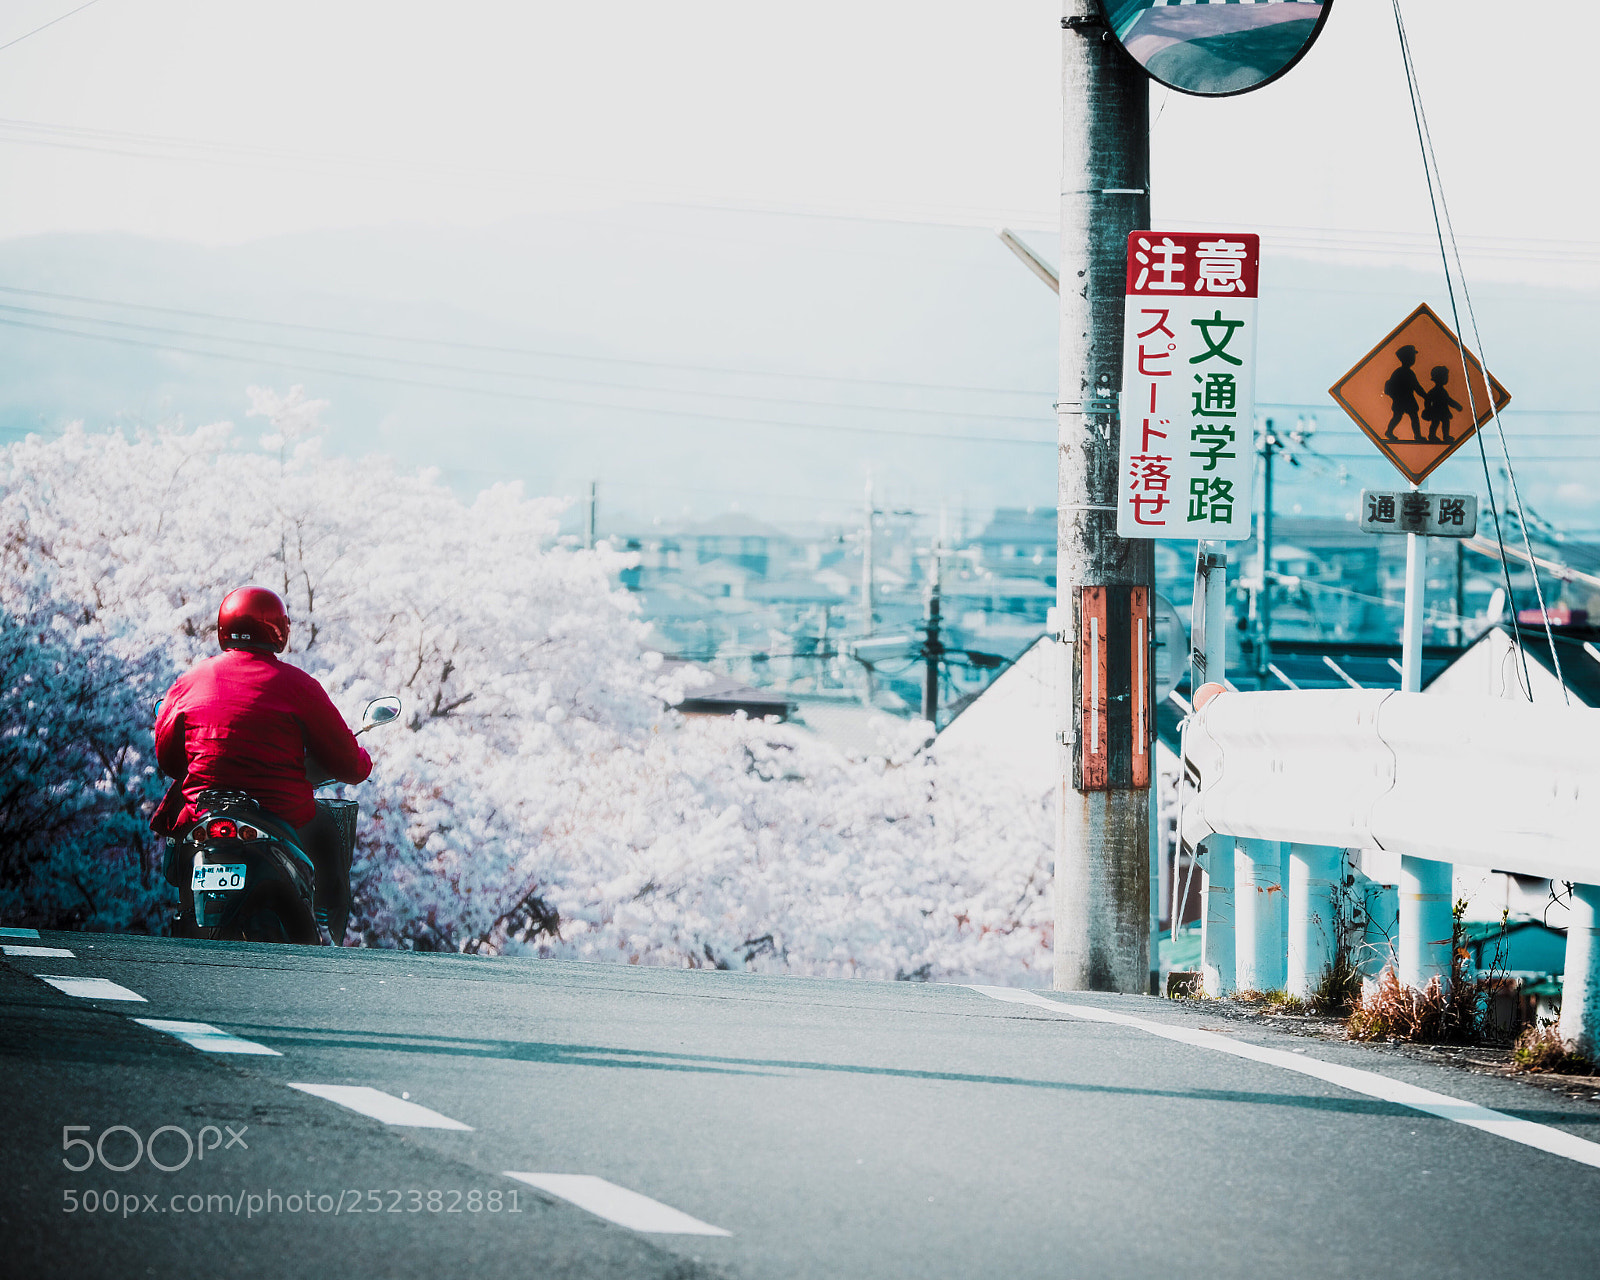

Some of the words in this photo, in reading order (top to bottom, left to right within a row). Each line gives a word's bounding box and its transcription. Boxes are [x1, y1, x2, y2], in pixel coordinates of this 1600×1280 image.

[1134, 237, 1247, 293] 注意
[1128, 308, 1177, 526] スピード落せ
[1367, 494, 1466, 526] 通学路
